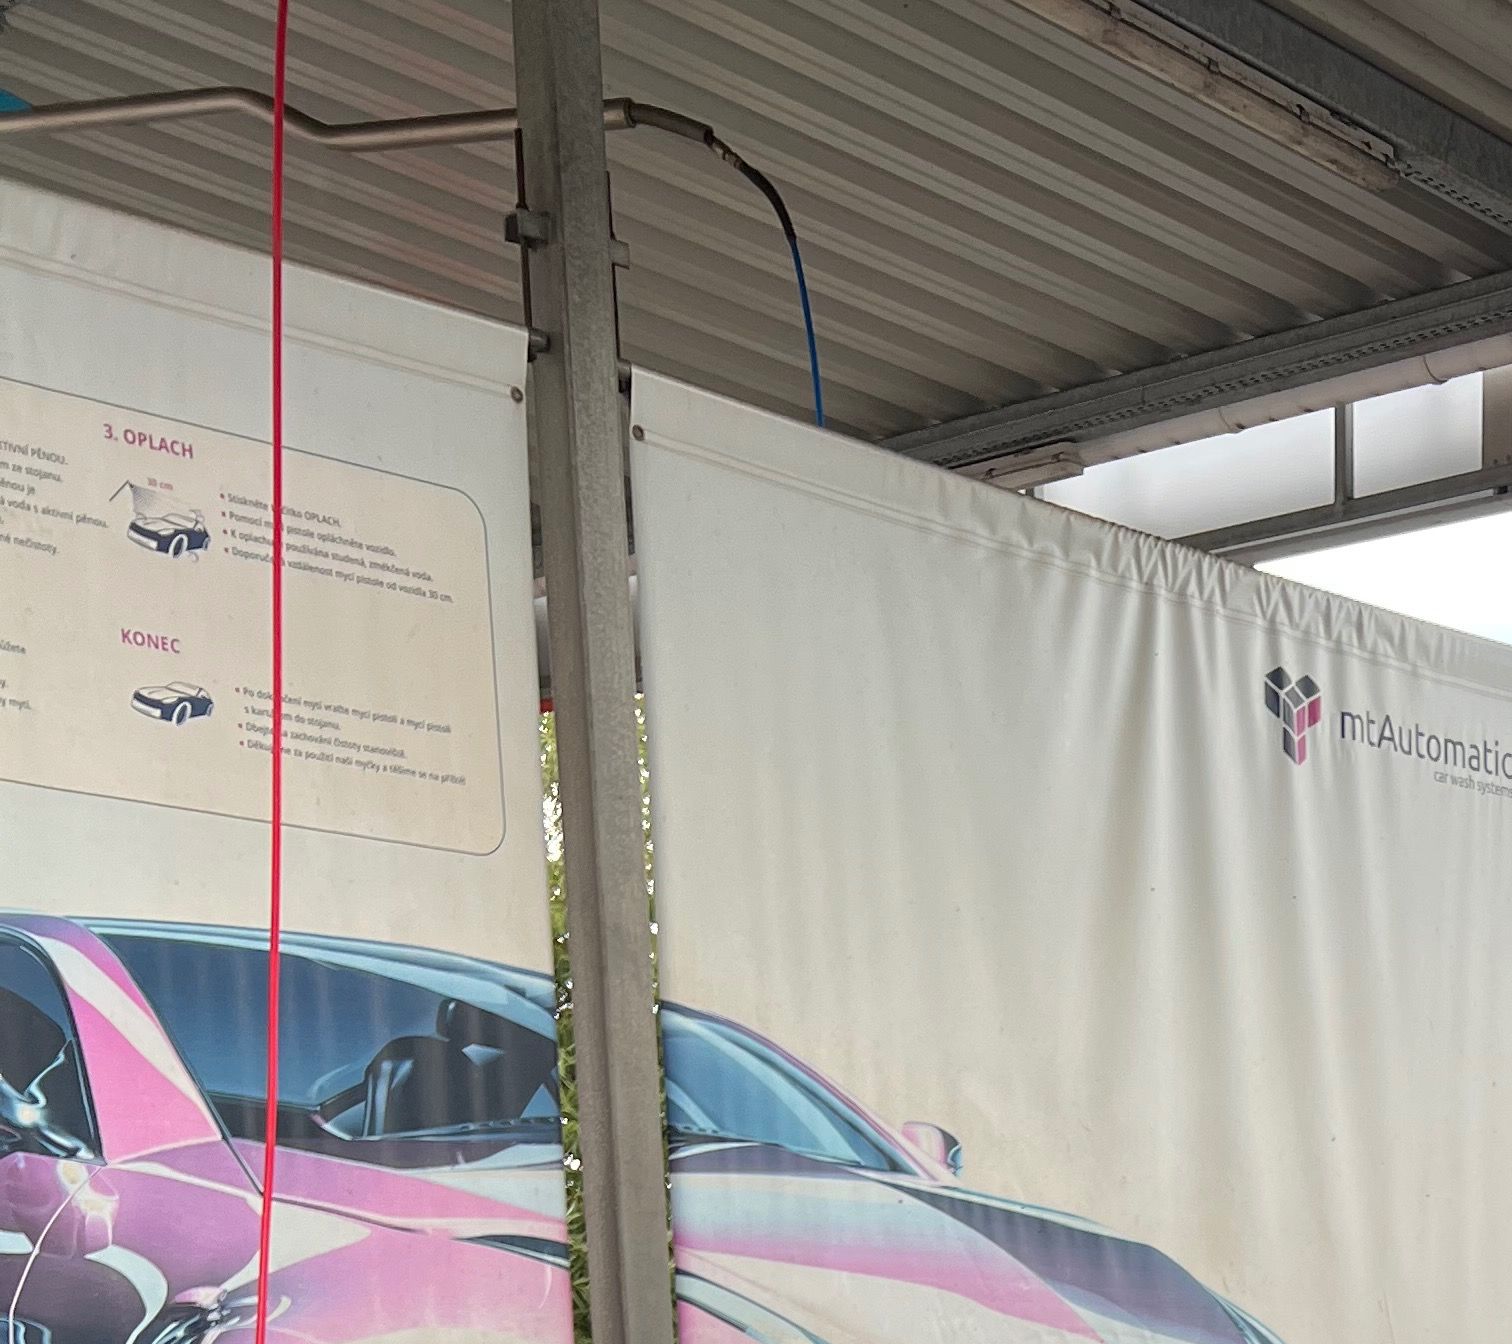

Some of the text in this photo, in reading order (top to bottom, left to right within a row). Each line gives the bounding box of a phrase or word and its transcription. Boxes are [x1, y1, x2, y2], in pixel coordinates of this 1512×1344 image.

[103, 423, 193, 459] 3. OPLACH
[121, 628, 180, 654] KONEC
[1340, 710, 1512, 780] mtAutomatic
